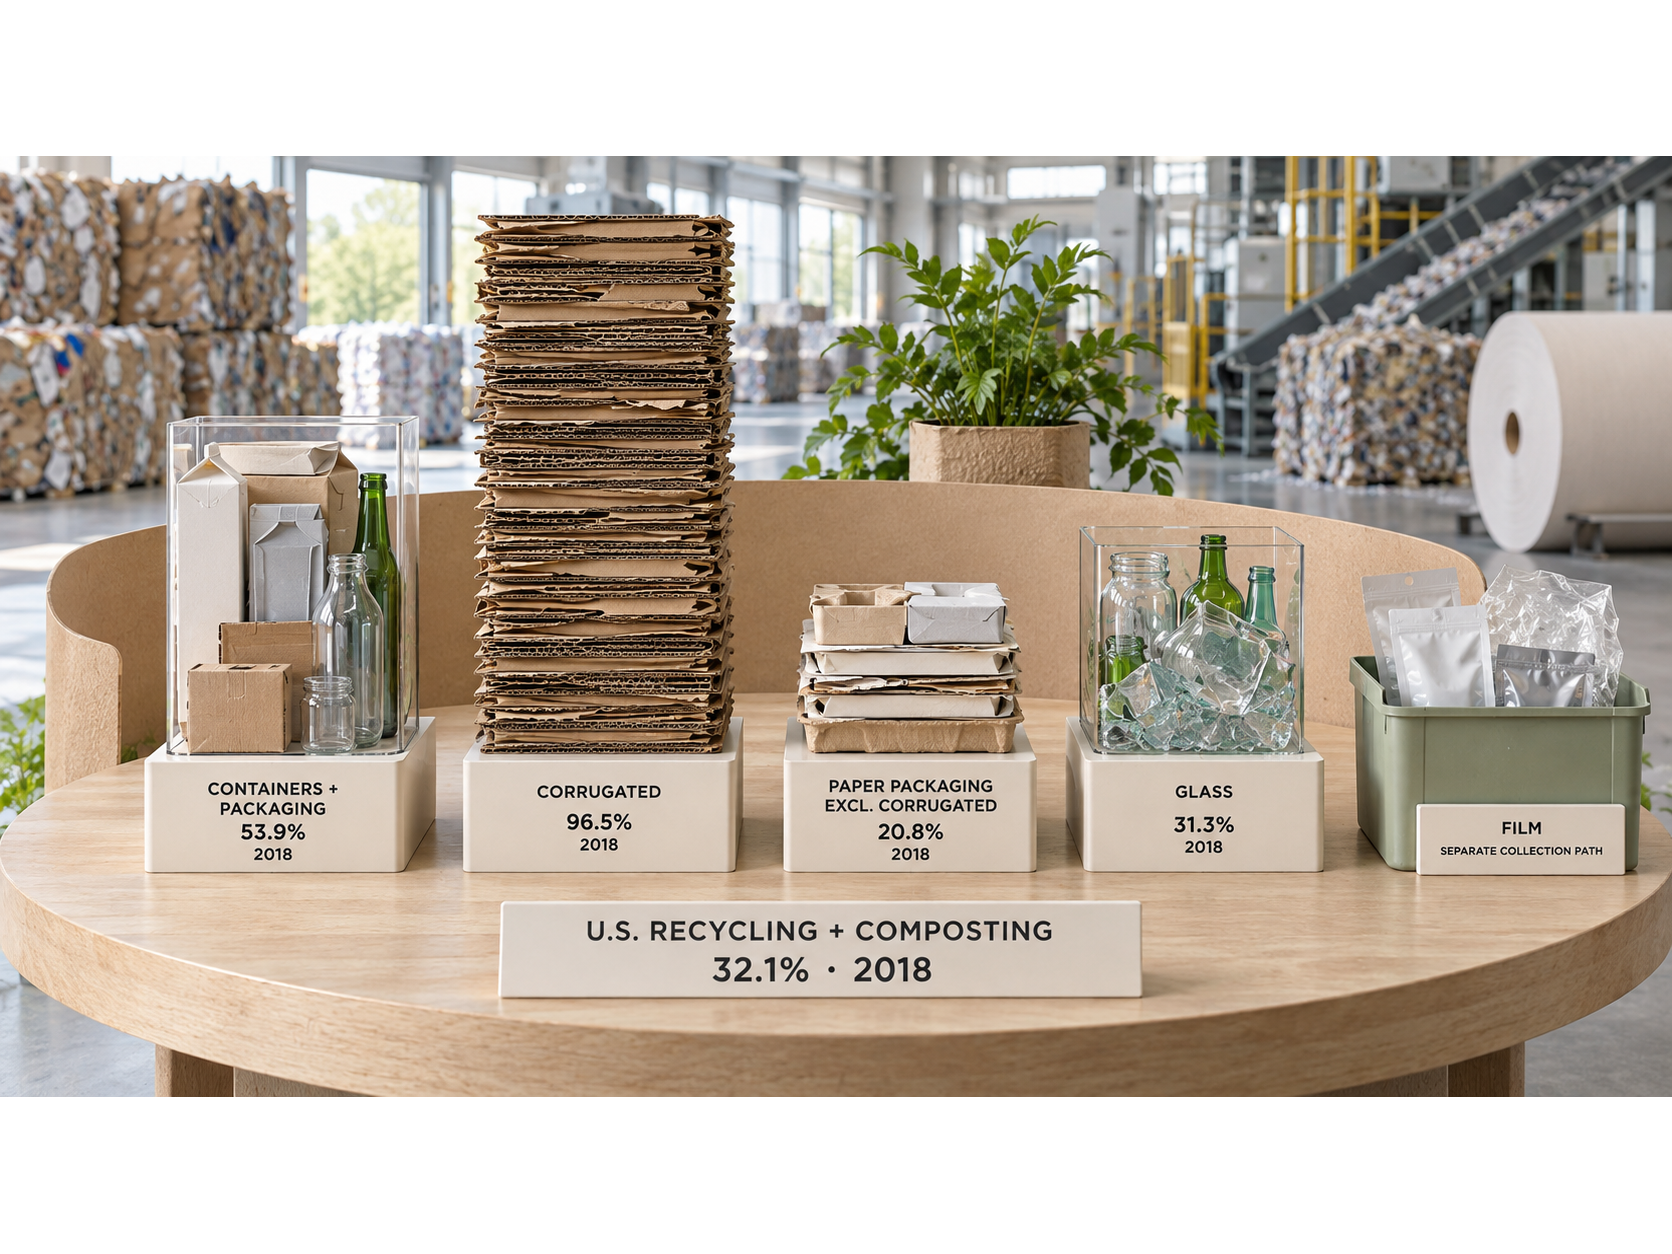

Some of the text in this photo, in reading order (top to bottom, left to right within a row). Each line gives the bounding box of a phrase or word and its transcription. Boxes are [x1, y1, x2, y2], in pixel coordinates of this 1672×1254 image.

[207, 781, 339, 796] CONTAINERS +
[536, 784, 662, 799] CORRUGATED
[828, 778, 994, 794] PAPER PACKAGING
[1175, 784, 1234, 799] GLASS
[220, 801, 326, 816] PACKAGING
[825, 798, 998, 813] EXCL. CORRUGATED
[566, 812, 633, 831] 96.5%
[1173, 815, 1235, 834] 31.3%
[1501, 820, 1542, 836] FILM
[240, 822, 306, 841] 53.9%
[877, 822, 944, 841] 20.8%
[579, 837, 619, 852] 2018
[1184, 839, 1224, 854] 2018
[1440, 846, 1603, 856] SEPARATE COLLECTION PATH
[253, 847, 293, 861] 2018
[891, 847, 931, 861] 2018
[587, 919, 1053, 942] U.S. RECYCLING + COMPOSTING
[712, 956, 810, 983] 32.1%
[853, 956, 932, 983] 2018
